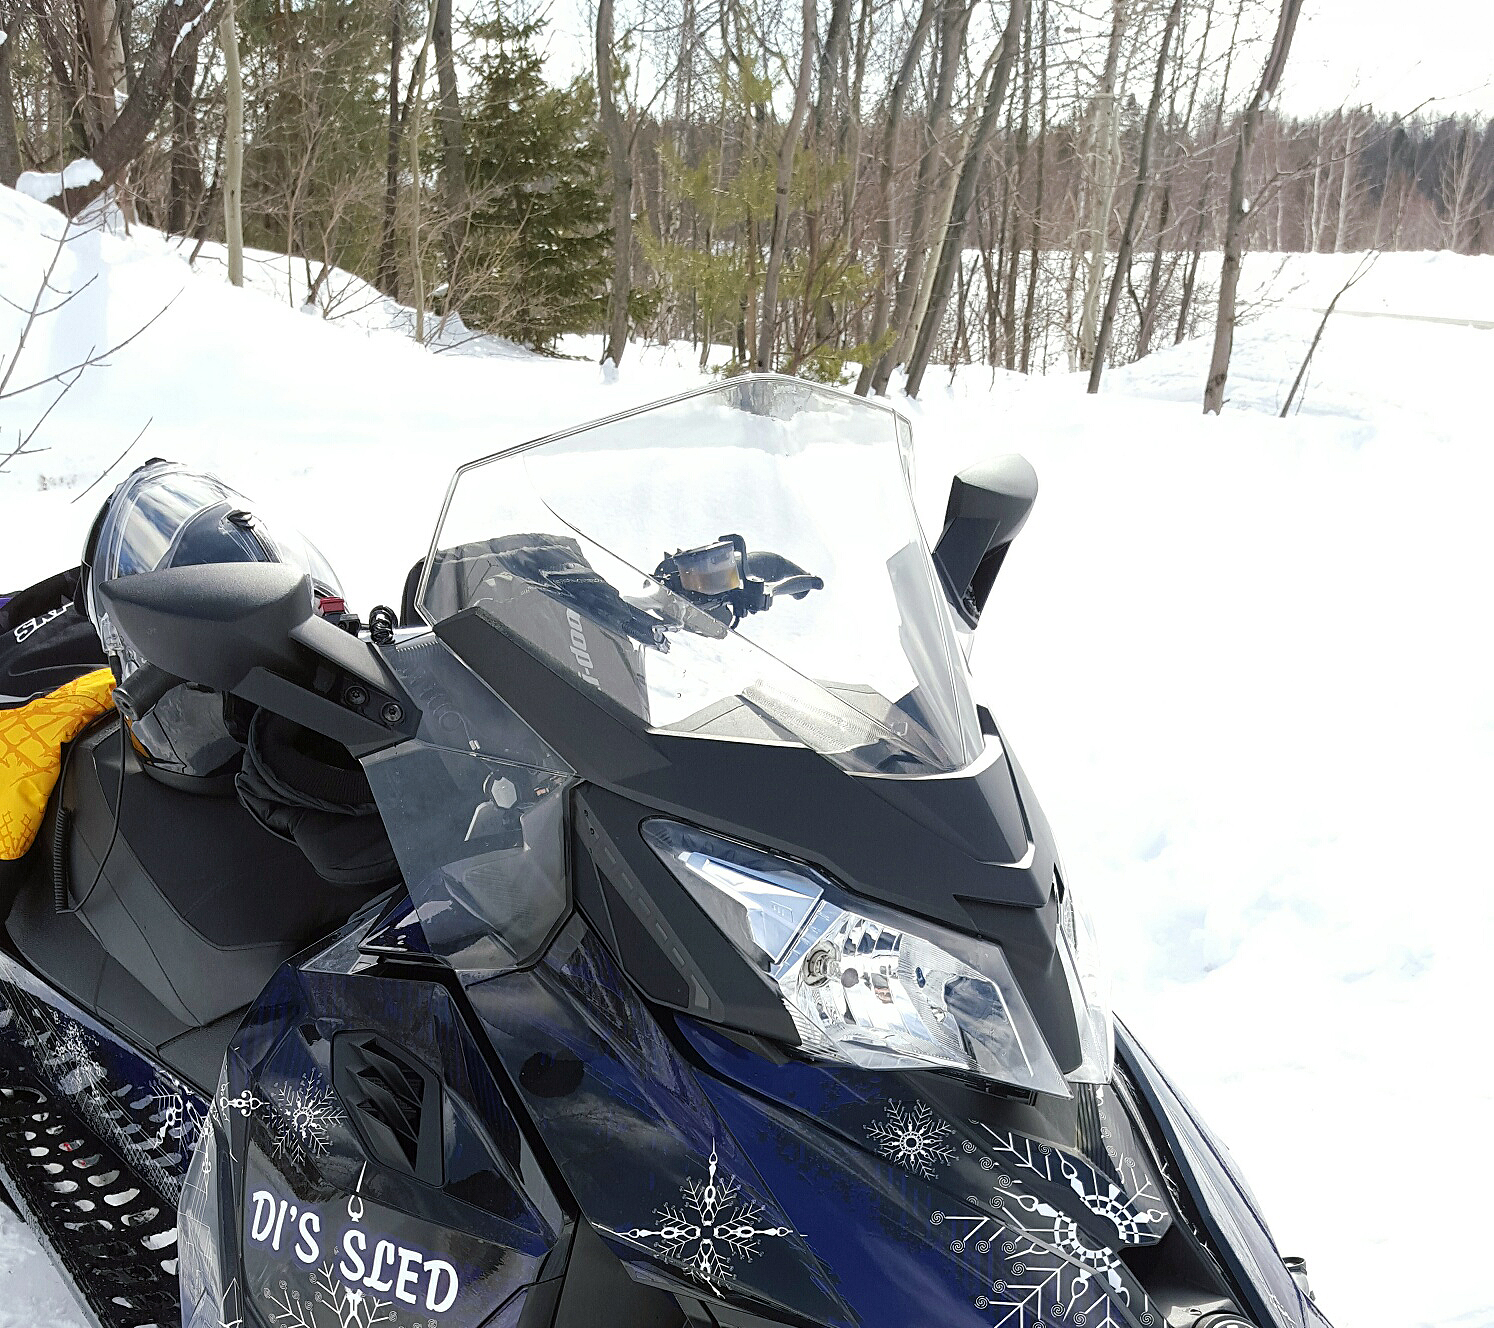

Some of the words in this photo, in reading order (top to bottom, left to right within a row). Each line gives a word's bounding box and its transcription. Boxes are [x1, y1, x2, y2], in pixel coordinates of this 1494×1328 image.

[566, 608, 602, 691] i-doo
[251, 1190, 321, 1264] DI'S
[339, 1229, 459, 1313] SLED
